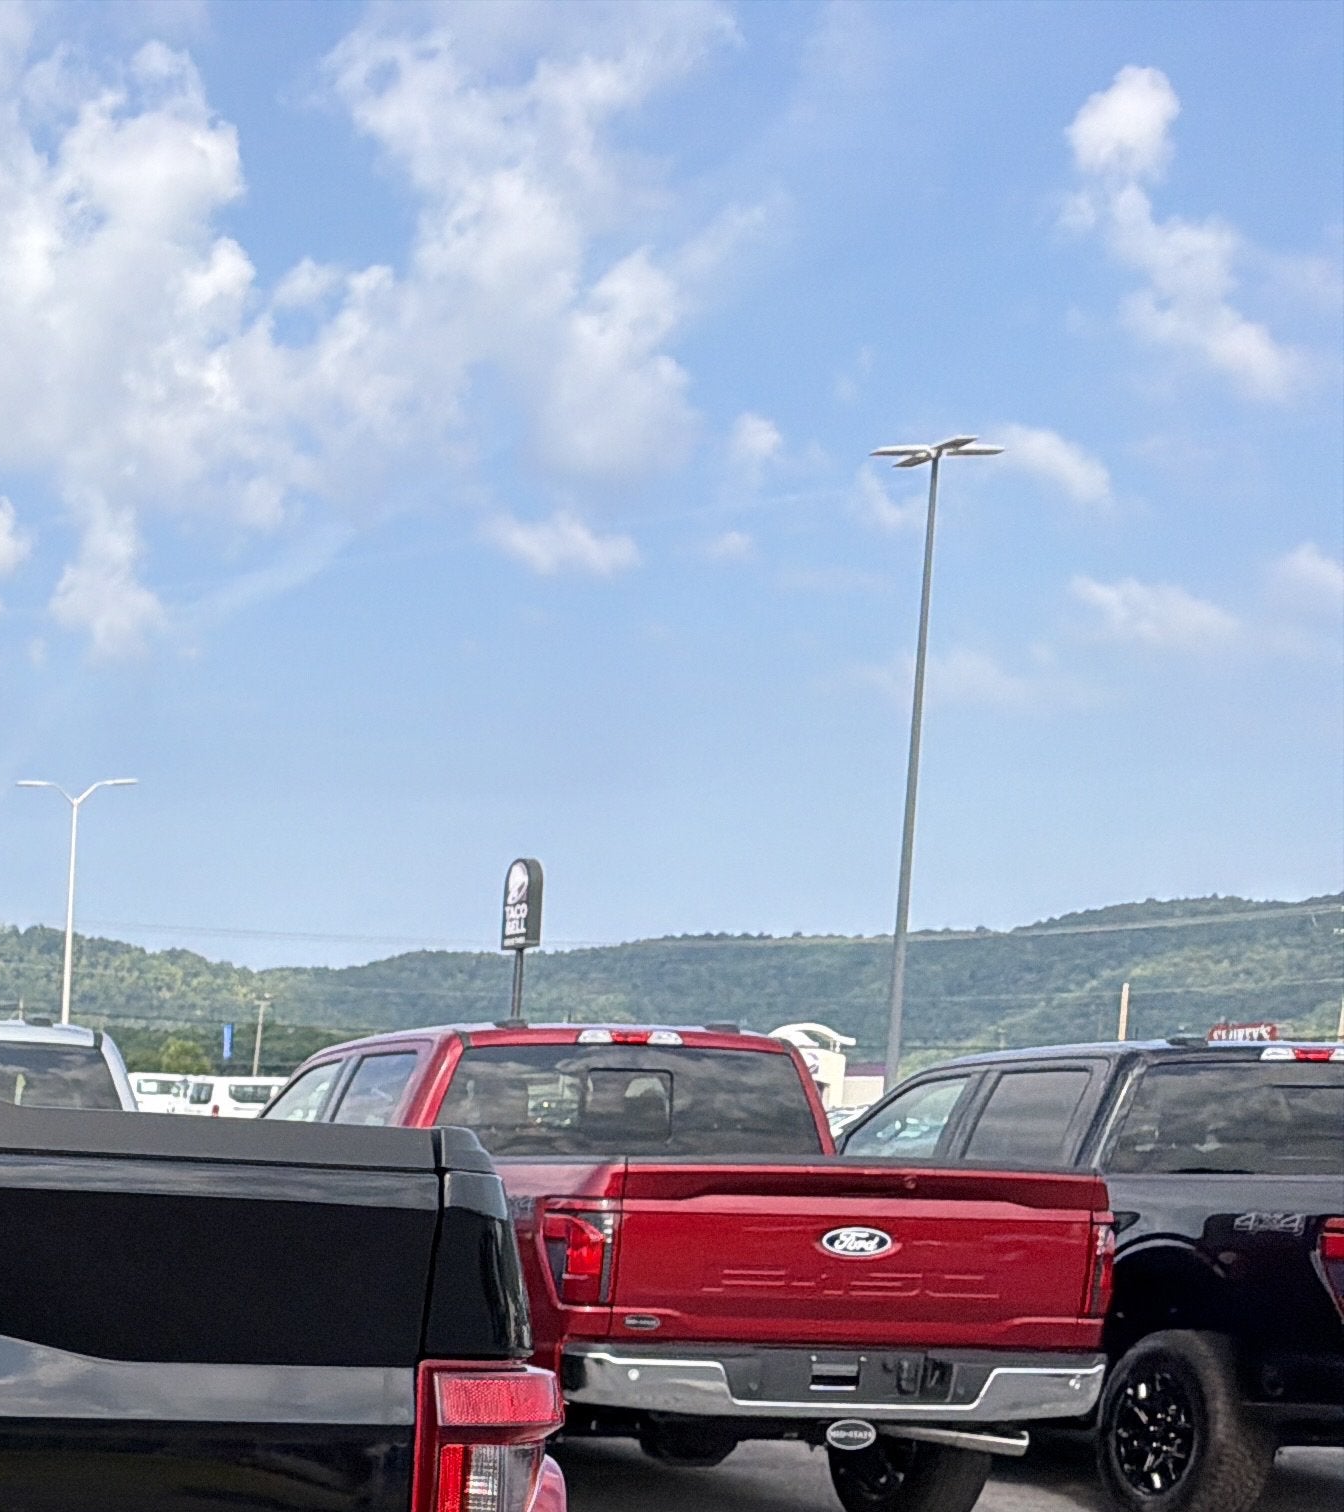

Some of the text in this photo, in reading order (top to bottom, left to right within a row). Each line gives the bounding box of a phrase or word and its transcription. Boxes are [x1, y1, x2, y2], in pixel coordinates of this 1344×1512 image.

[505, 903, 528, 919] TACO
[505, 918, 527, 936] BELL
[833, 1231, 880, 1251] Ford
